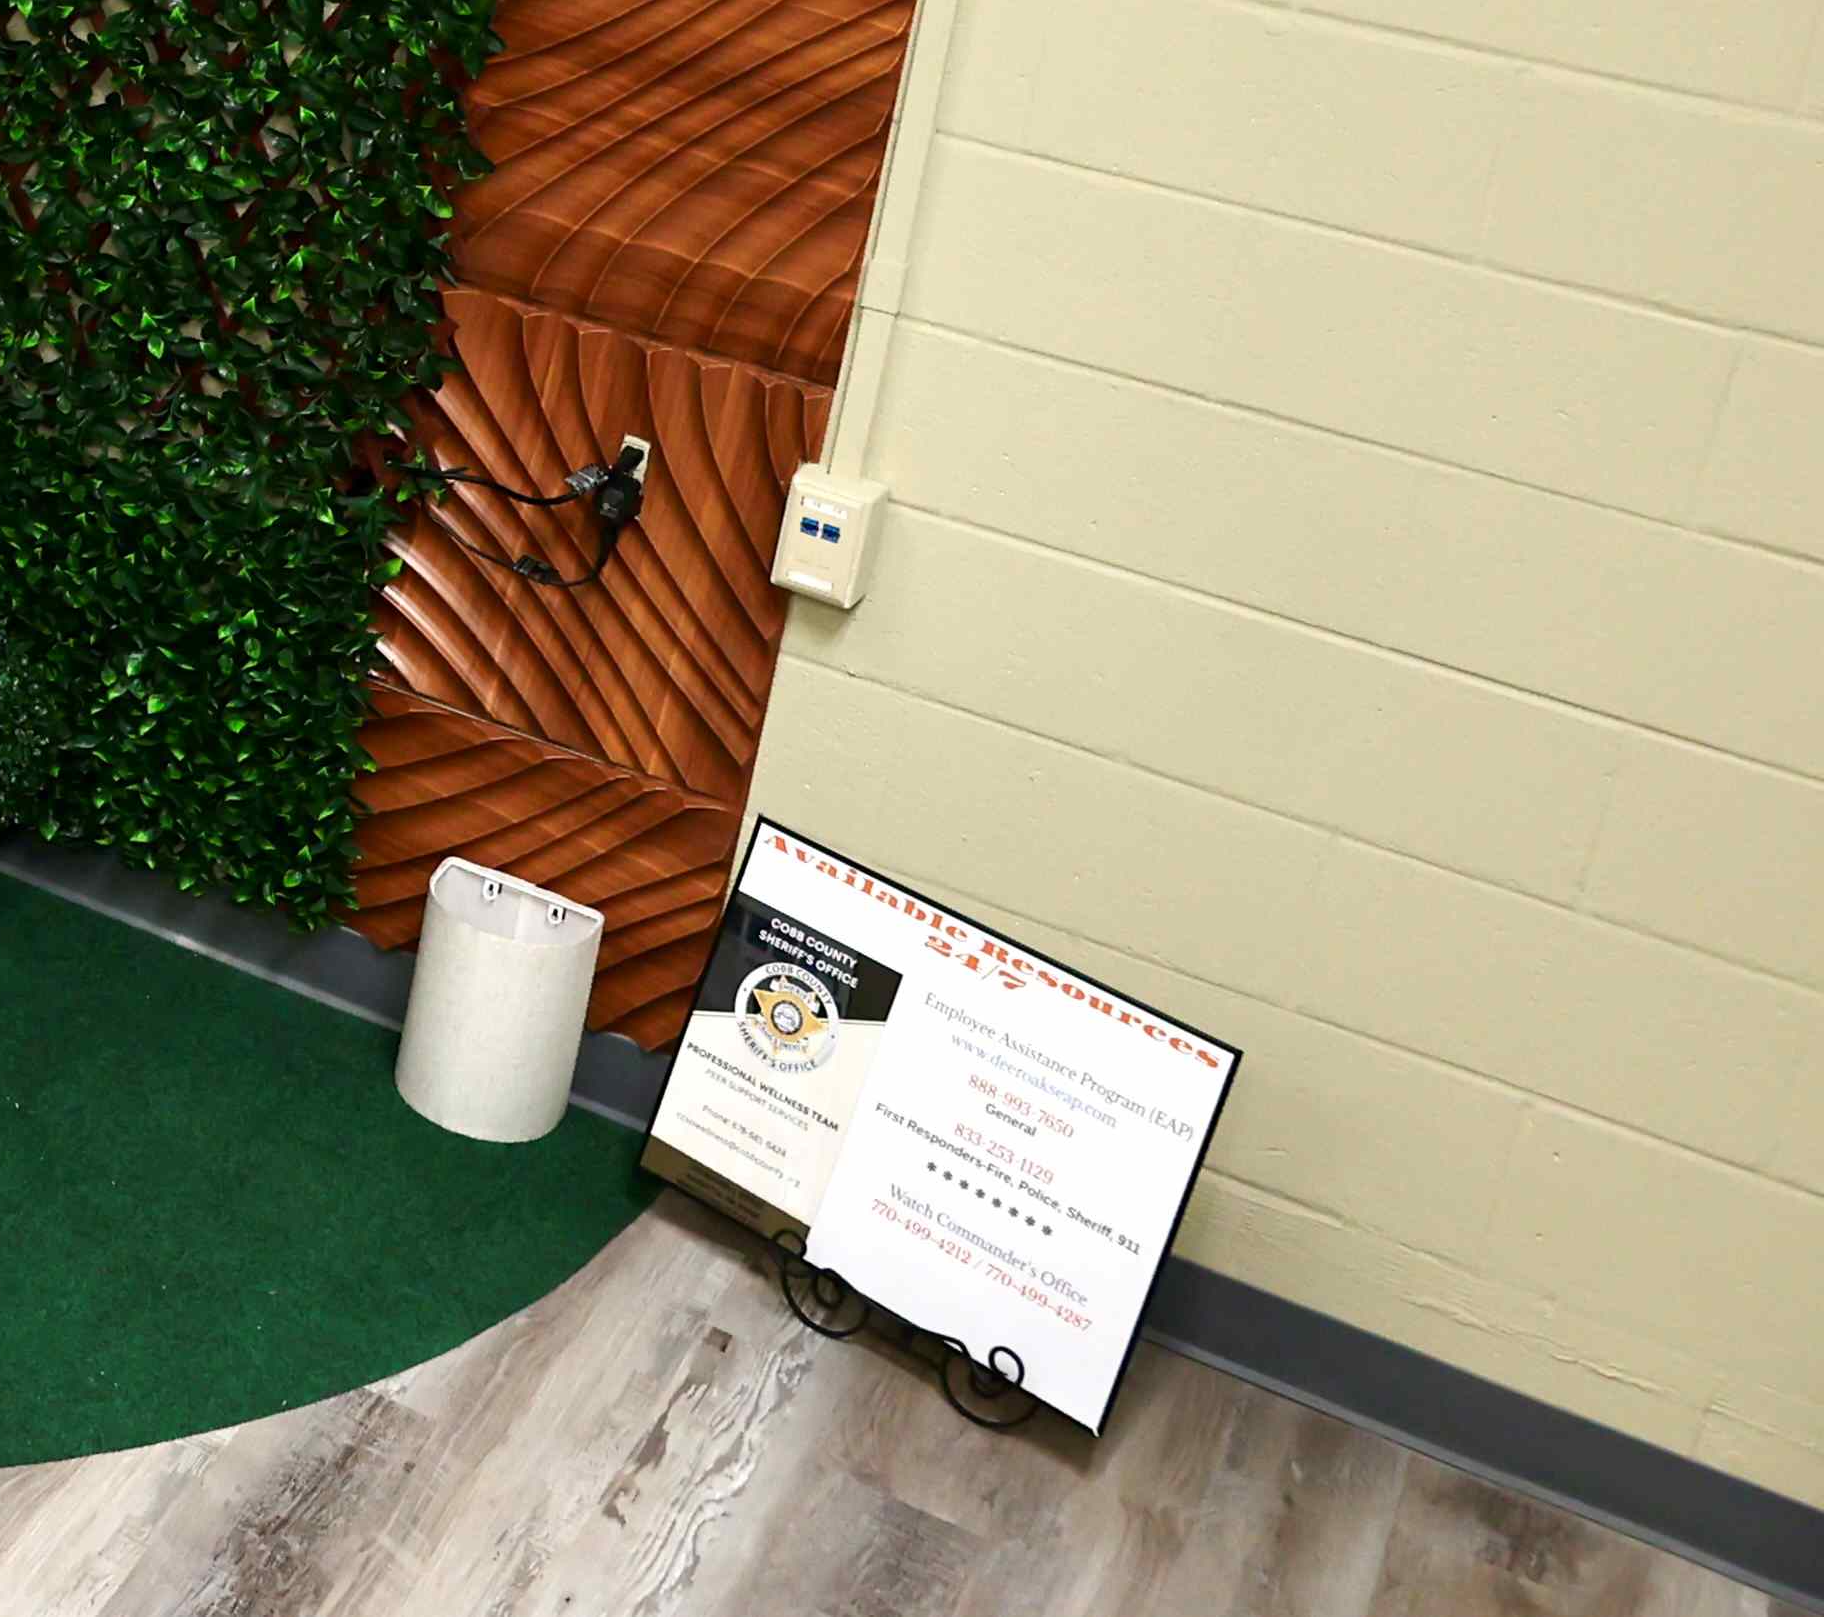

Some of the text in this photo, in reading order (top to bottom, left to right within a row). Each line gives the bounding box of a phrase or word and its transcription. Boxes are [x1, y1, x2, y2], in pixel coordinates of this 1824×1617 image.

[759, 930, 859, 989] SHERIFF'S OFFICE
[764, 833, 1220, 1069] Available Resources
[770, 918, 858, 969] COBB COUNTY
[924, 936, 1030, 990] 24/7
[766, 965, 833, 1005] COBB COUNTY
[686, 1042, 839, 1132] PROFESSIONAL WELLNESS TEAM
[780, 1060, 817, 1073] OFFICE
[925, 992, 1194, 1141] Employee Assistance Program (EAP)
[952, 1034, 1117, 1128] www.deeroakseap.com
[705, 1069, 809, 1131] PEER SUPPORT SERVICES
[968, 1074, 1074, 1138] 888-993-7650
[985, 1103, 1037, 1137] General
[875, 1103, 904, 1125] First
[1018, 1180, 1062, 1213] Police,
[1066, 1206, 1113, 1242] Sheriff,
[1117, 1235, 1141, 1255] 911
[954, 1123, 1054, 1185] 833-253-1129
[890, 1184, 1088, 1306] Watch Commander's Office
